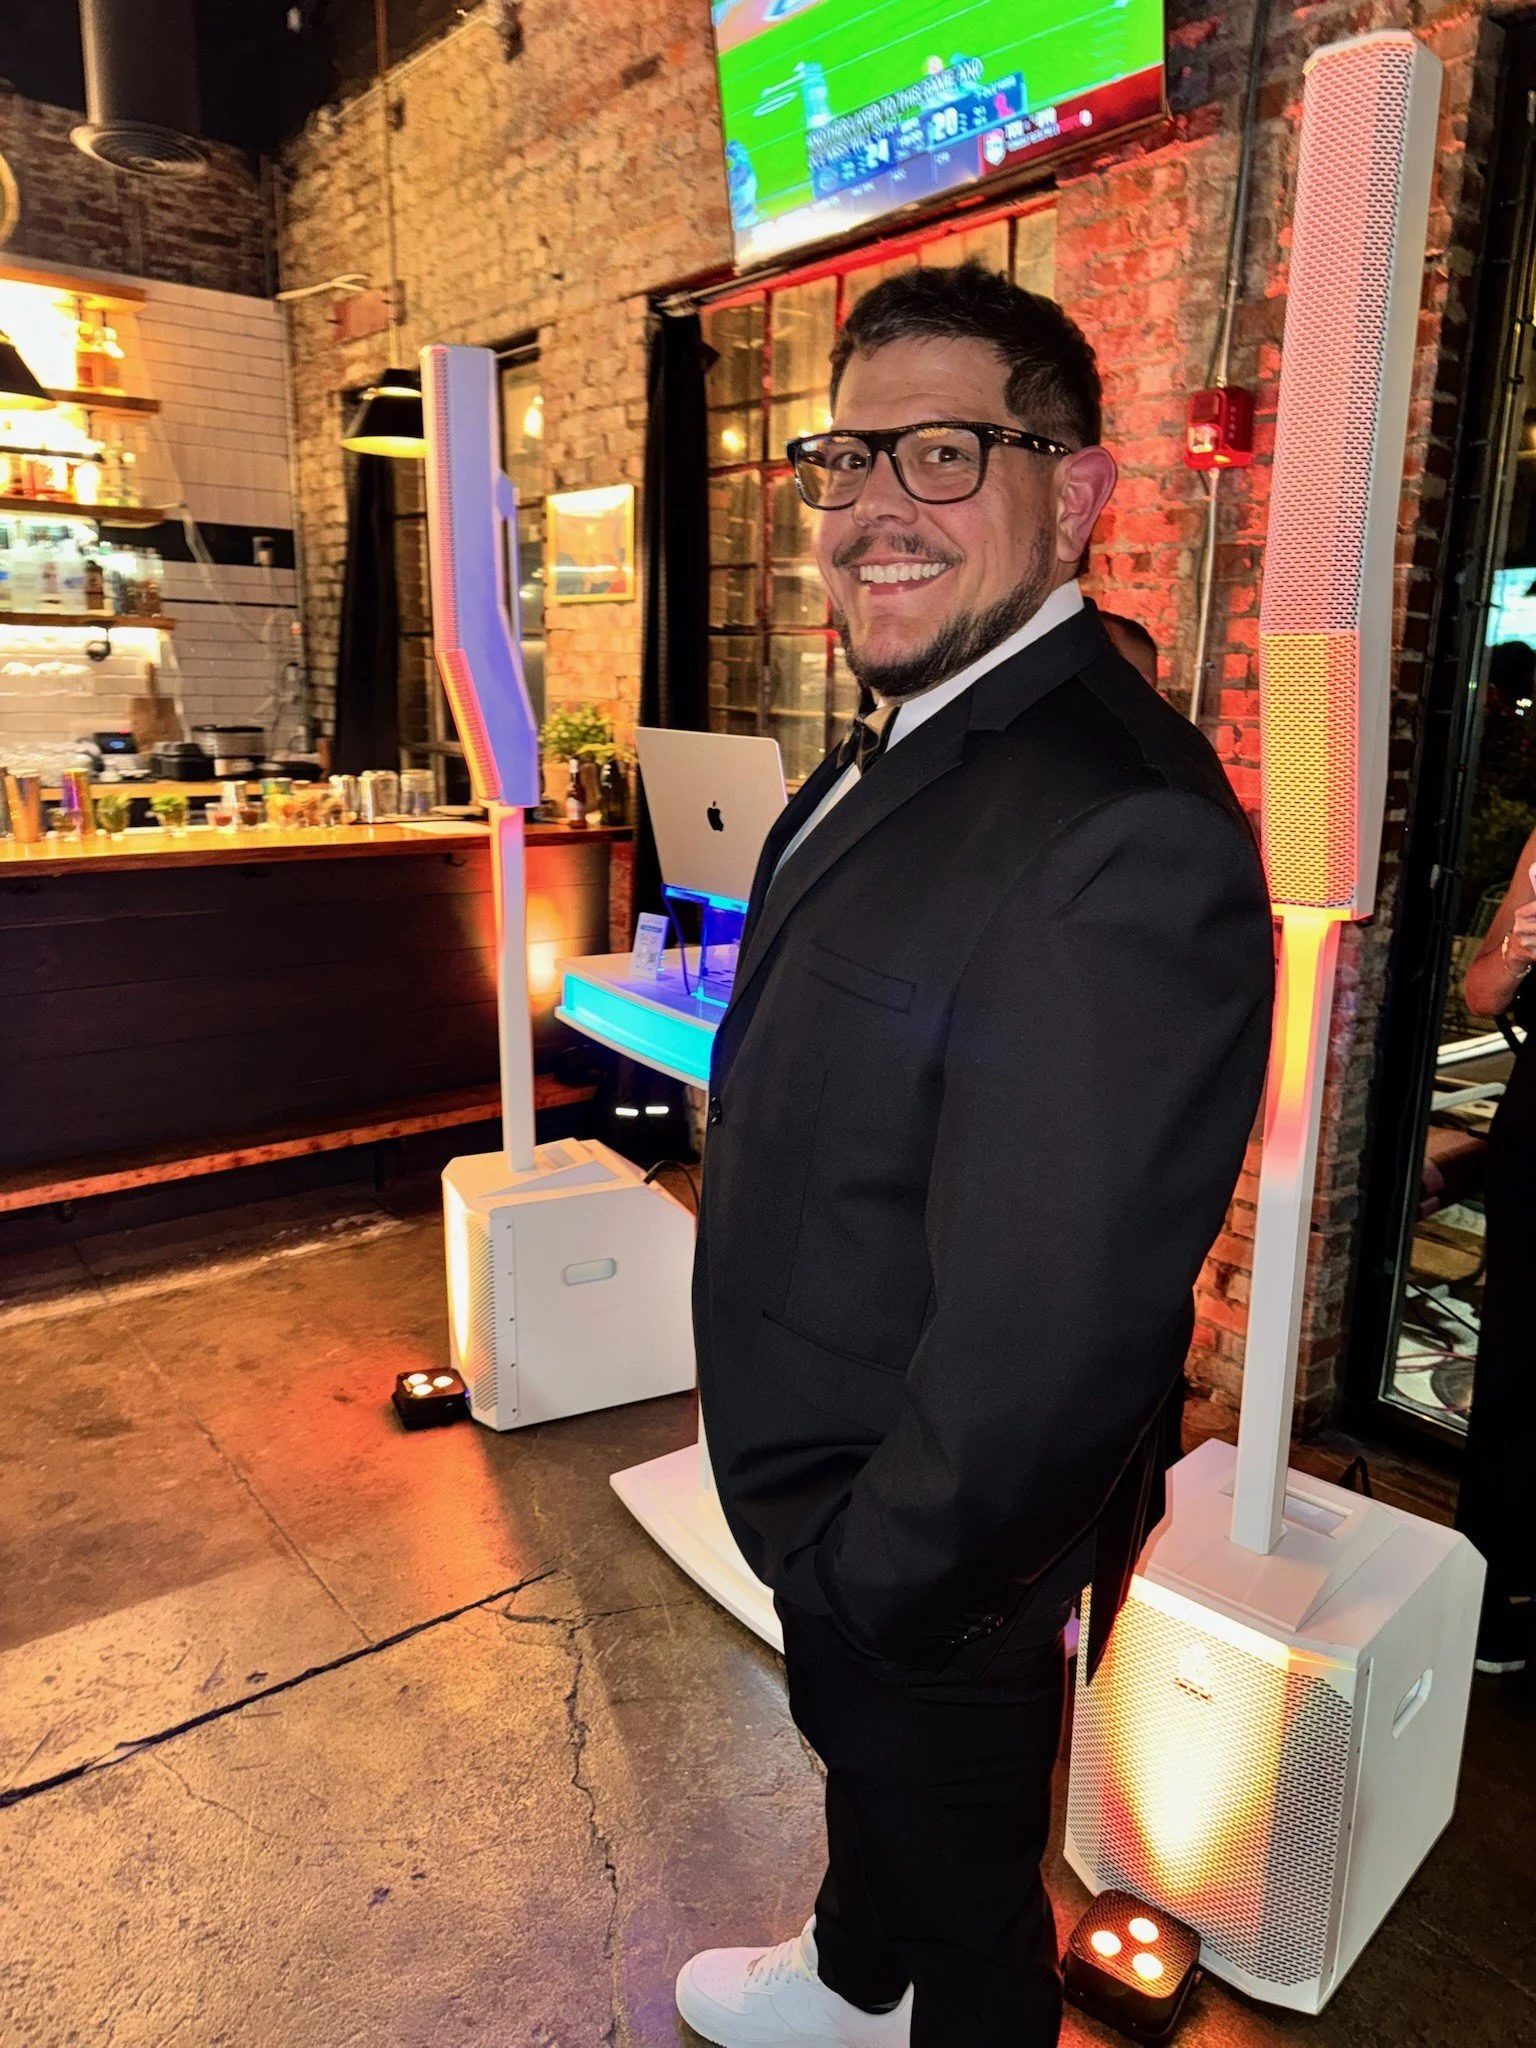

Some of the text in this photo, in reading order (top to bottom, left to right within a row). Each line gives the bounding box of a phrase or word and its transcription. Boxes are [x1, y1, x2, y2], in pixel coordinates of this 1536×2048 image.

[957, 57, 984, 82] AND
[932, 107, 958, 141] 20
[865, 138, 889, 169] 24
